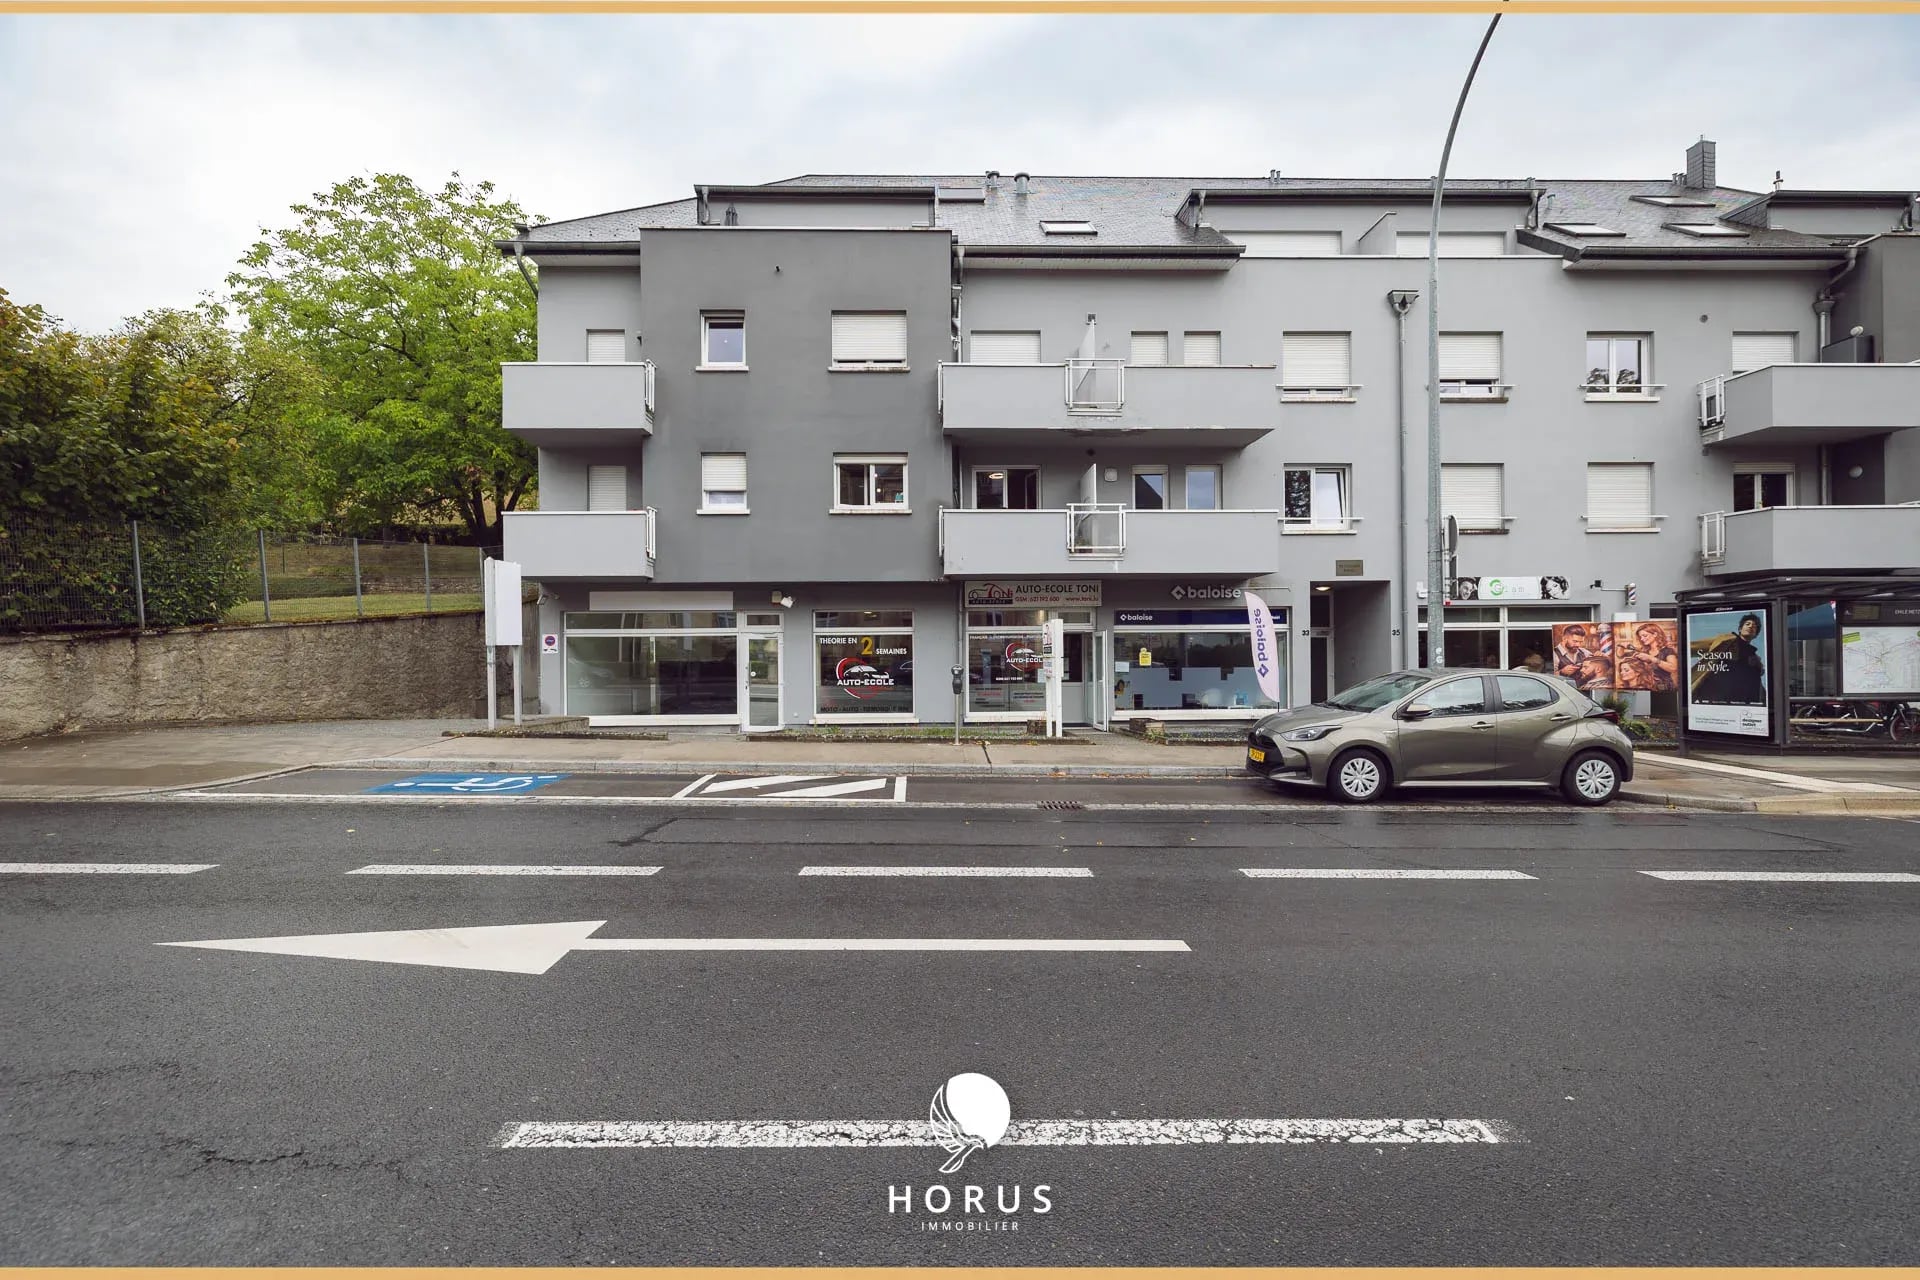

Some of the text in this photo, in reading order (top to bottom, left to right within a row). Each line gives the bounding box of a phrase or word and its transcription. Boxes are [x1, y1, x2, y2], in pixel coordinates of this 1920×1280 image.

[1015, 584, 1099, 593] AUTO-ECOLE TONI
[1187, 585, 1241, 599] baloise
[1127, 613, 1153, 621] baloise
[860, 636, 874, 655] 2
[1696, 649, 1733, 661] Season
[1697, 661, 1730, 674] in Style.
[837, 678, 895, 686] AUTO-ECOLE
